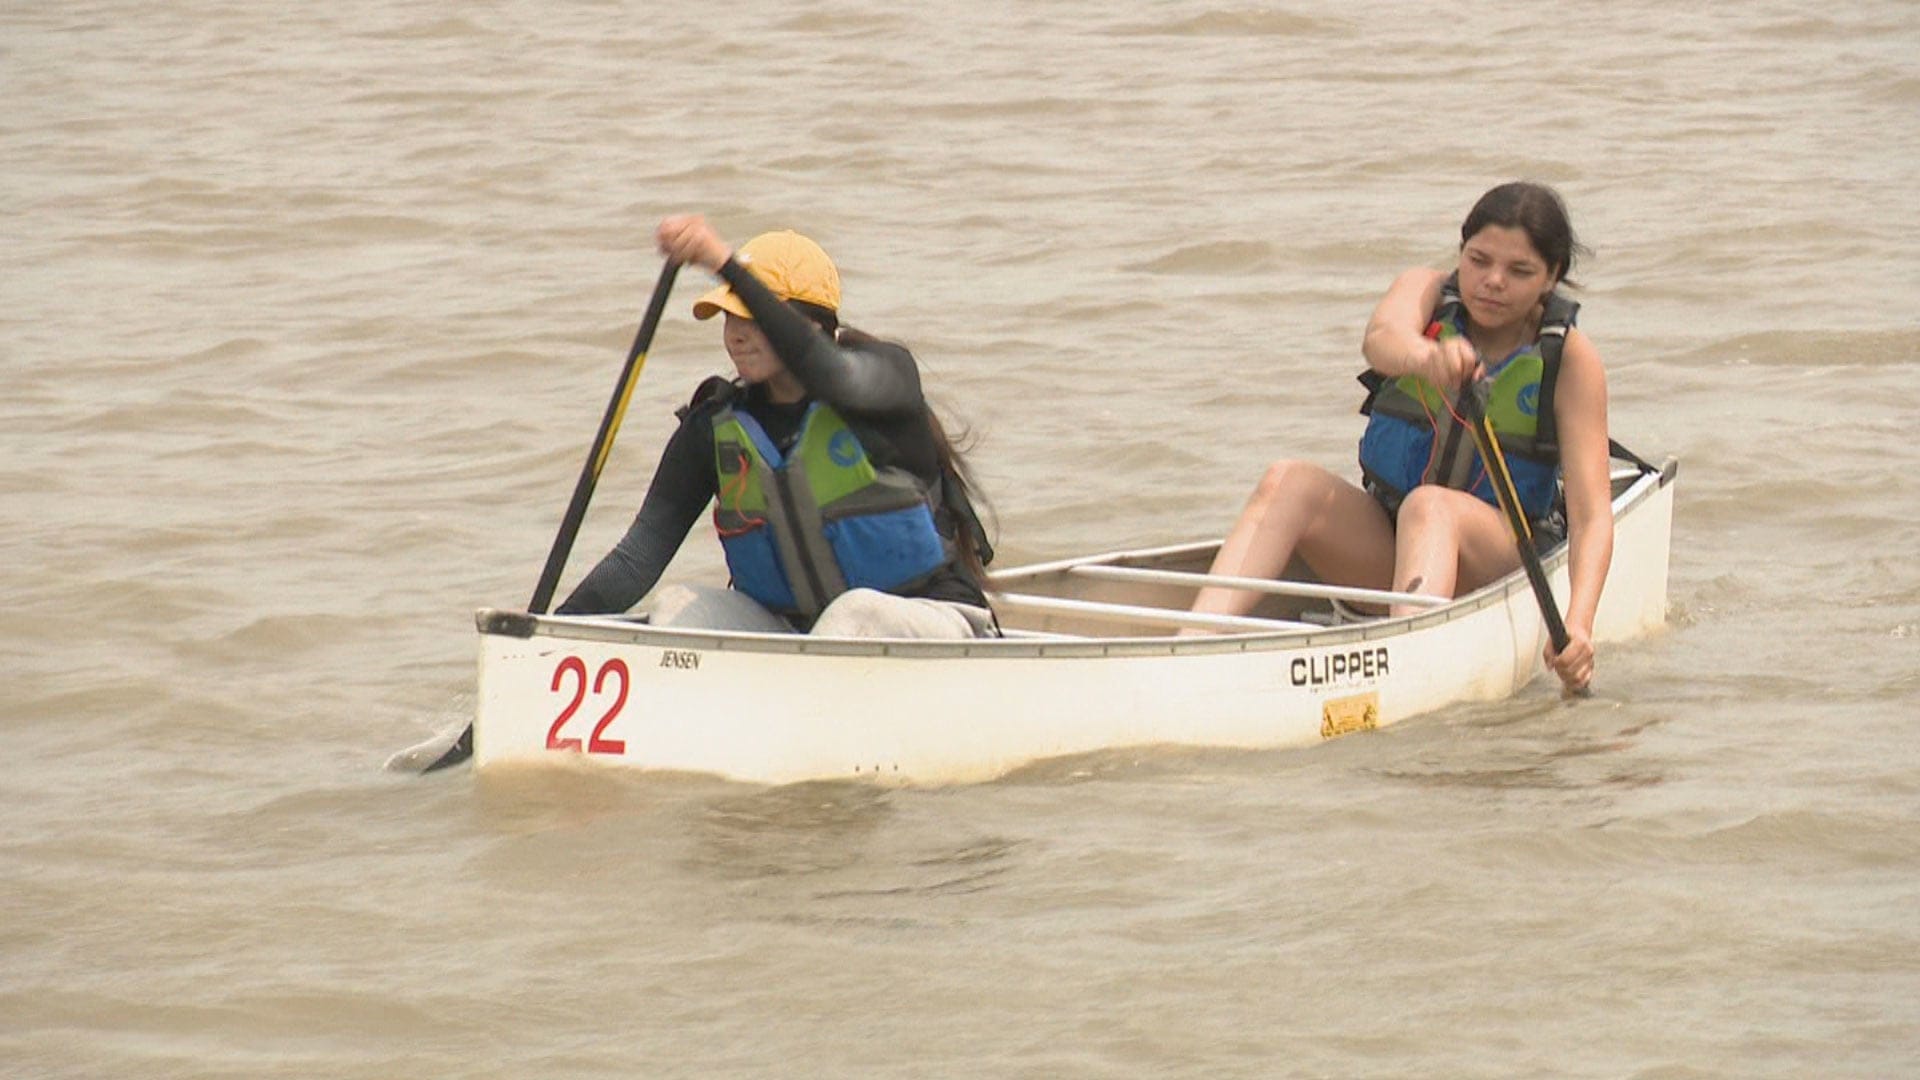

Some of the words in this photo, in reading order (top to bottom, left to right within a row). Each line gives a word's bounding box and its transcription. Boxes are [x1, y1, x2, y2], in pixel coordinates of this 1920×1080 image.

[660, 650, 701, 670] JENSEN
[1291, 647, 1389, 686] CLIPPER
[546, 656, 629, 755] 22
